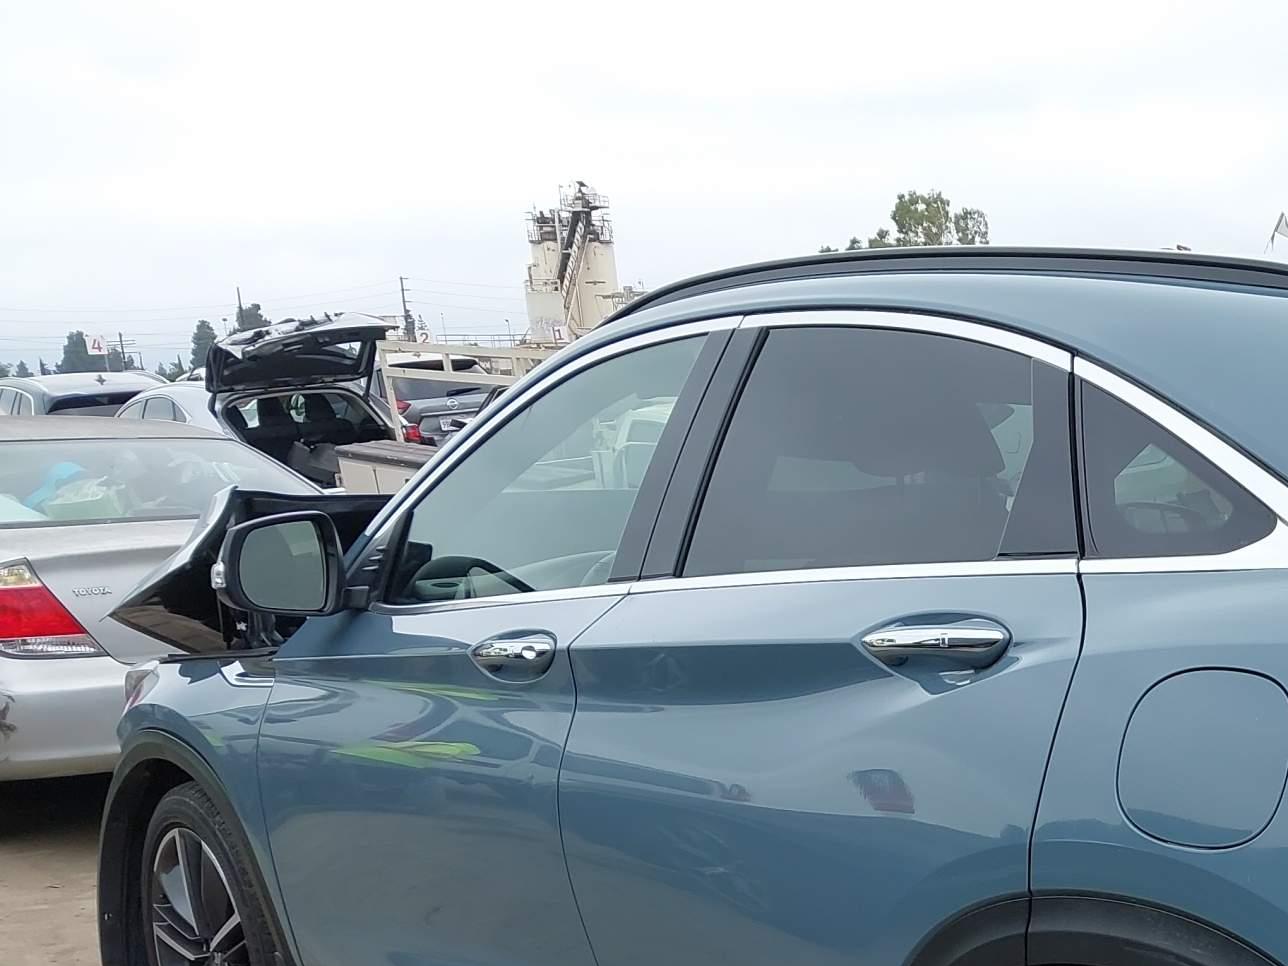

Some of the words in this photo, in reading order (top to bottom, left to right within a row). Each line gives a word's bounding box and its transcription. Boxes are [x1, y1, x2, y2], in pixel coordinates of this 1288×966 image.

[419, 332, 430, 344] 2
[91, 338, 103, 353] 4
[71, 585, 112, 597] TOYOTA
